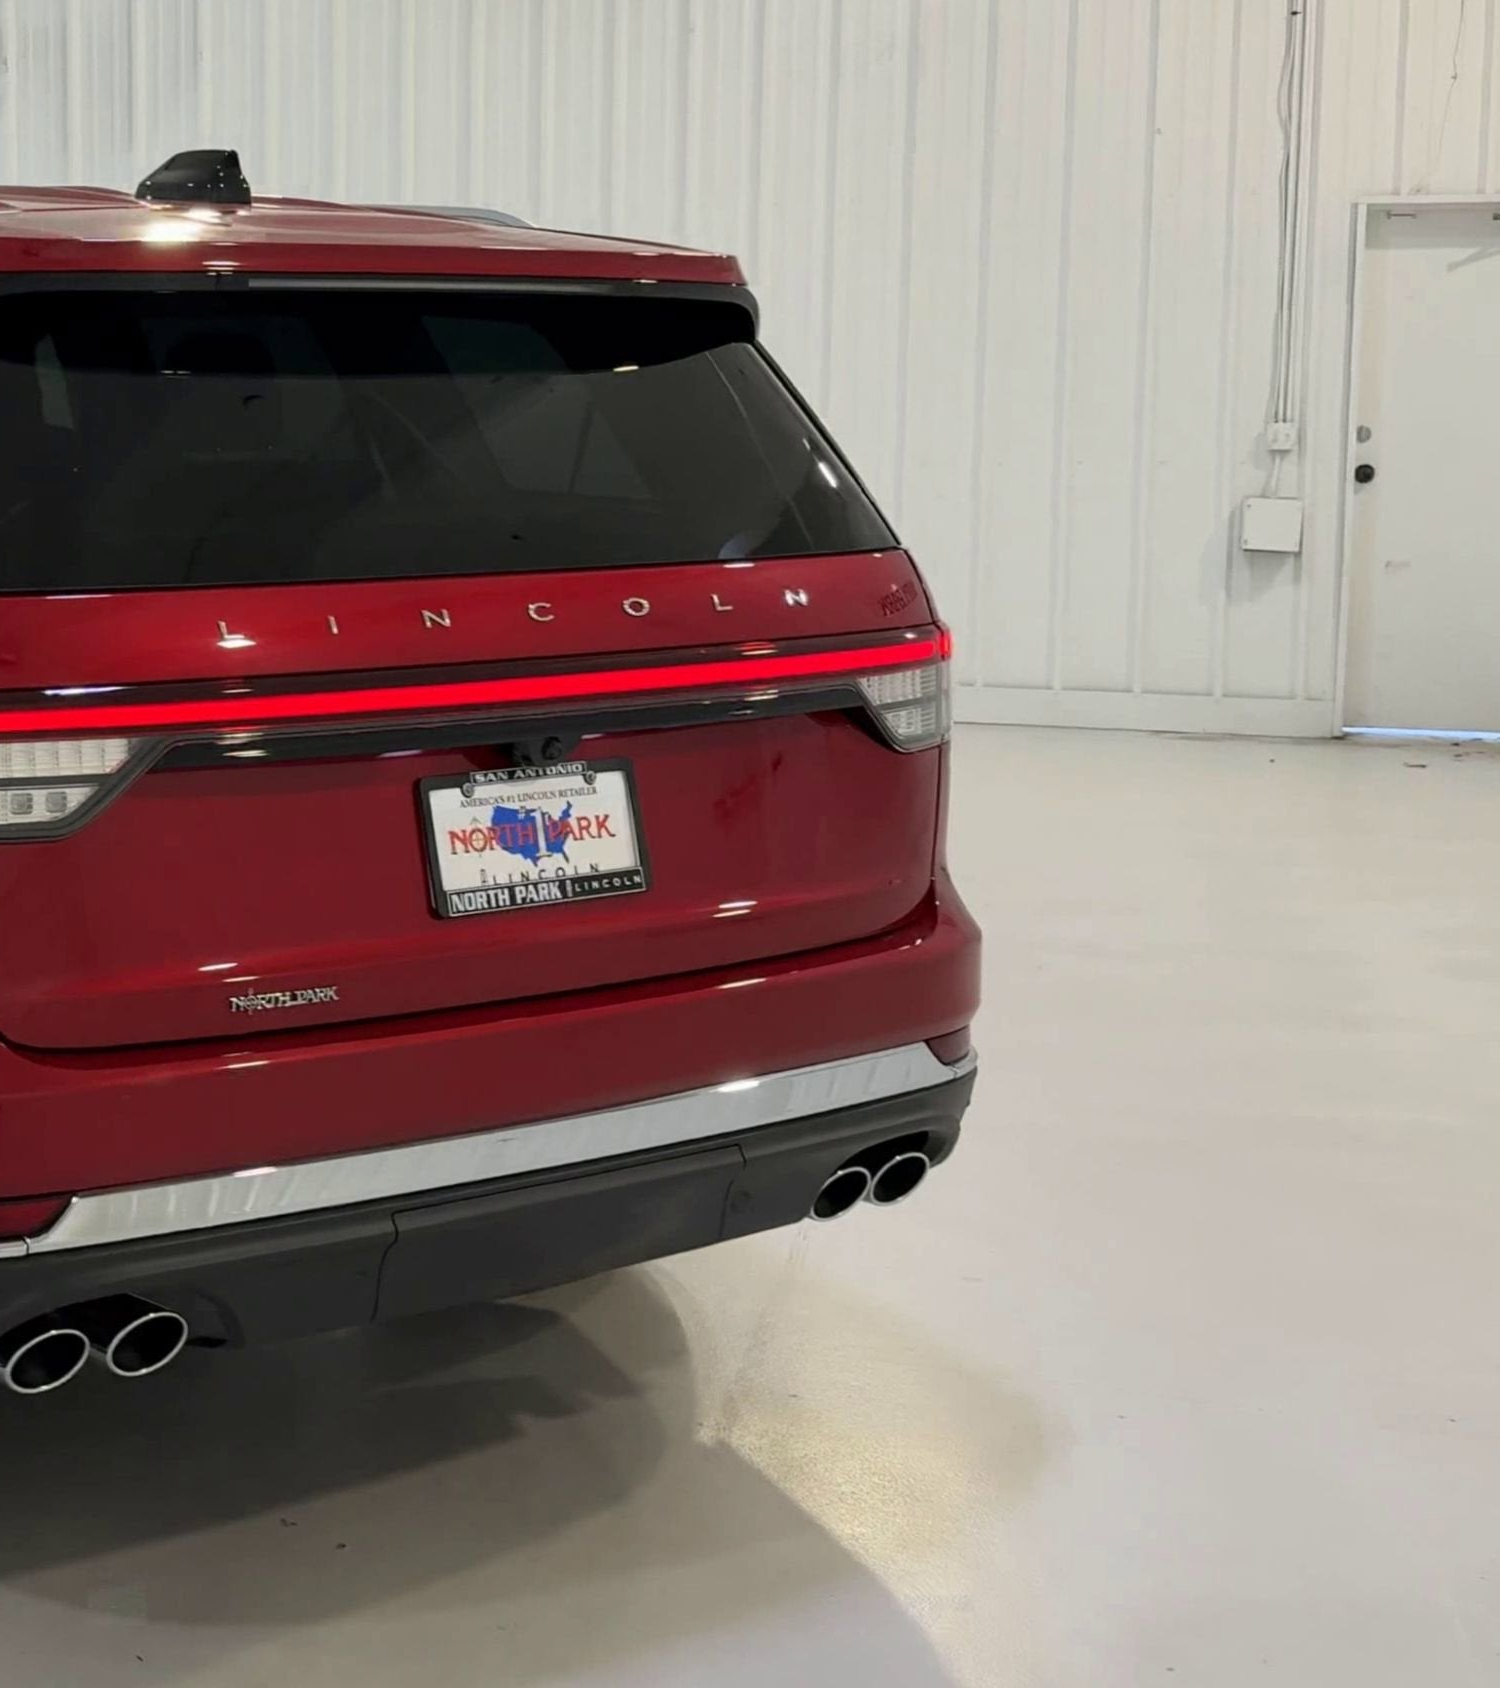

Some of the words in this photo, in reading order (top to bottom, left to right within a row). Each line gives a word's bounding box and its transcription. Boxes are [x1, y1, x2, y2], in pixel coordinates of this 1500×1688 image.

[218, 587, 810, 639] LINCOLN
[475, 771, 509, 783] SAN
[514, 763, 583, 779] ANTONIO
[517, 789, 557, 803] LINCOLN
[558, 786, 598, 798] RETAILER
[448, 824, 537, 855] NORTH
[549, 814, 617, 842] PARK
[451, 889, 510, 913] NORTH
[515, 881, 563, 905] PARK
[575, 876, 642, 893] LINCOLN
